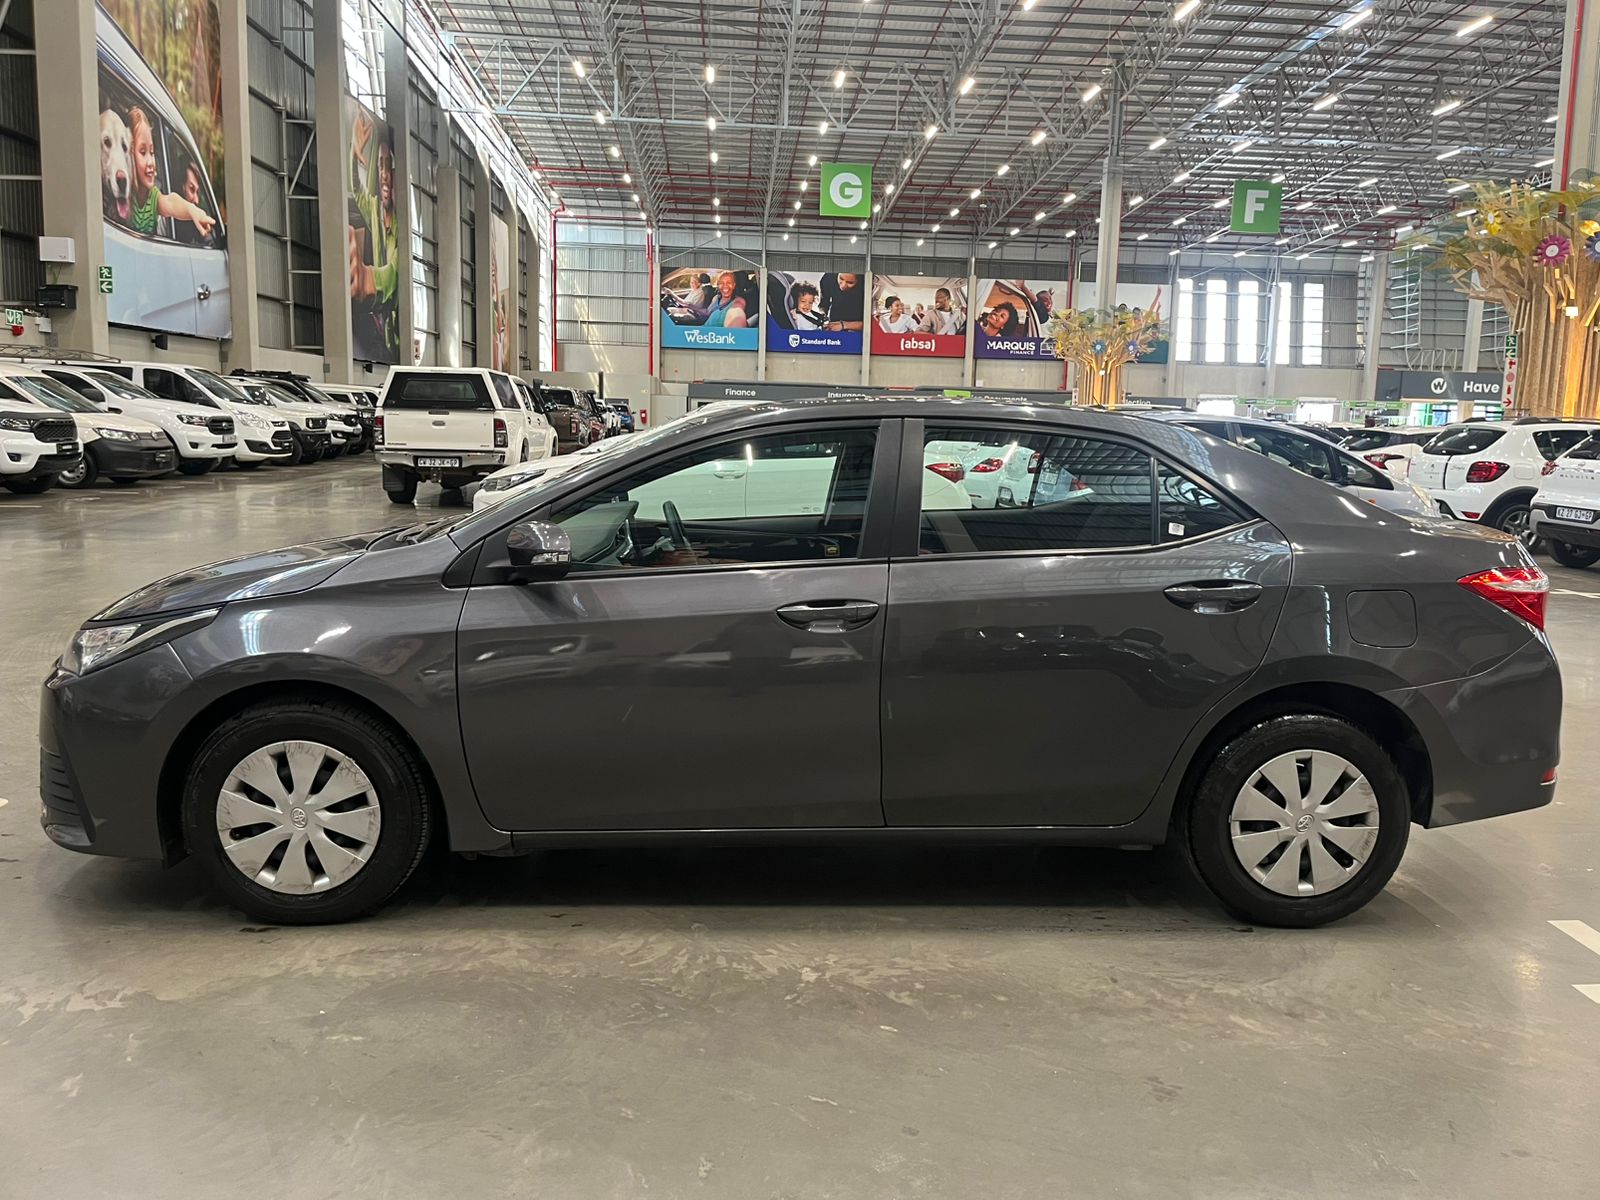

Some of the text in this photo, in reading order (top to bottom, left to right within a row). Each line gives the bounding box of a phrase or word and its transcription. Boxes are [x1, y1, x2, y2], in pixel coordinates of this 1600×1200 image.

[828, 172, 863, 208] G
[1243, 189, 1270, 224] F
[684, 330, 736, 345] WesBank
[801, 337, 842, 346] Standard Bank
[987, 340, 1036, 351] MARQUIS
[725, 388, 756, 397] Finance
[1463, 380, 1500, 393] Have
